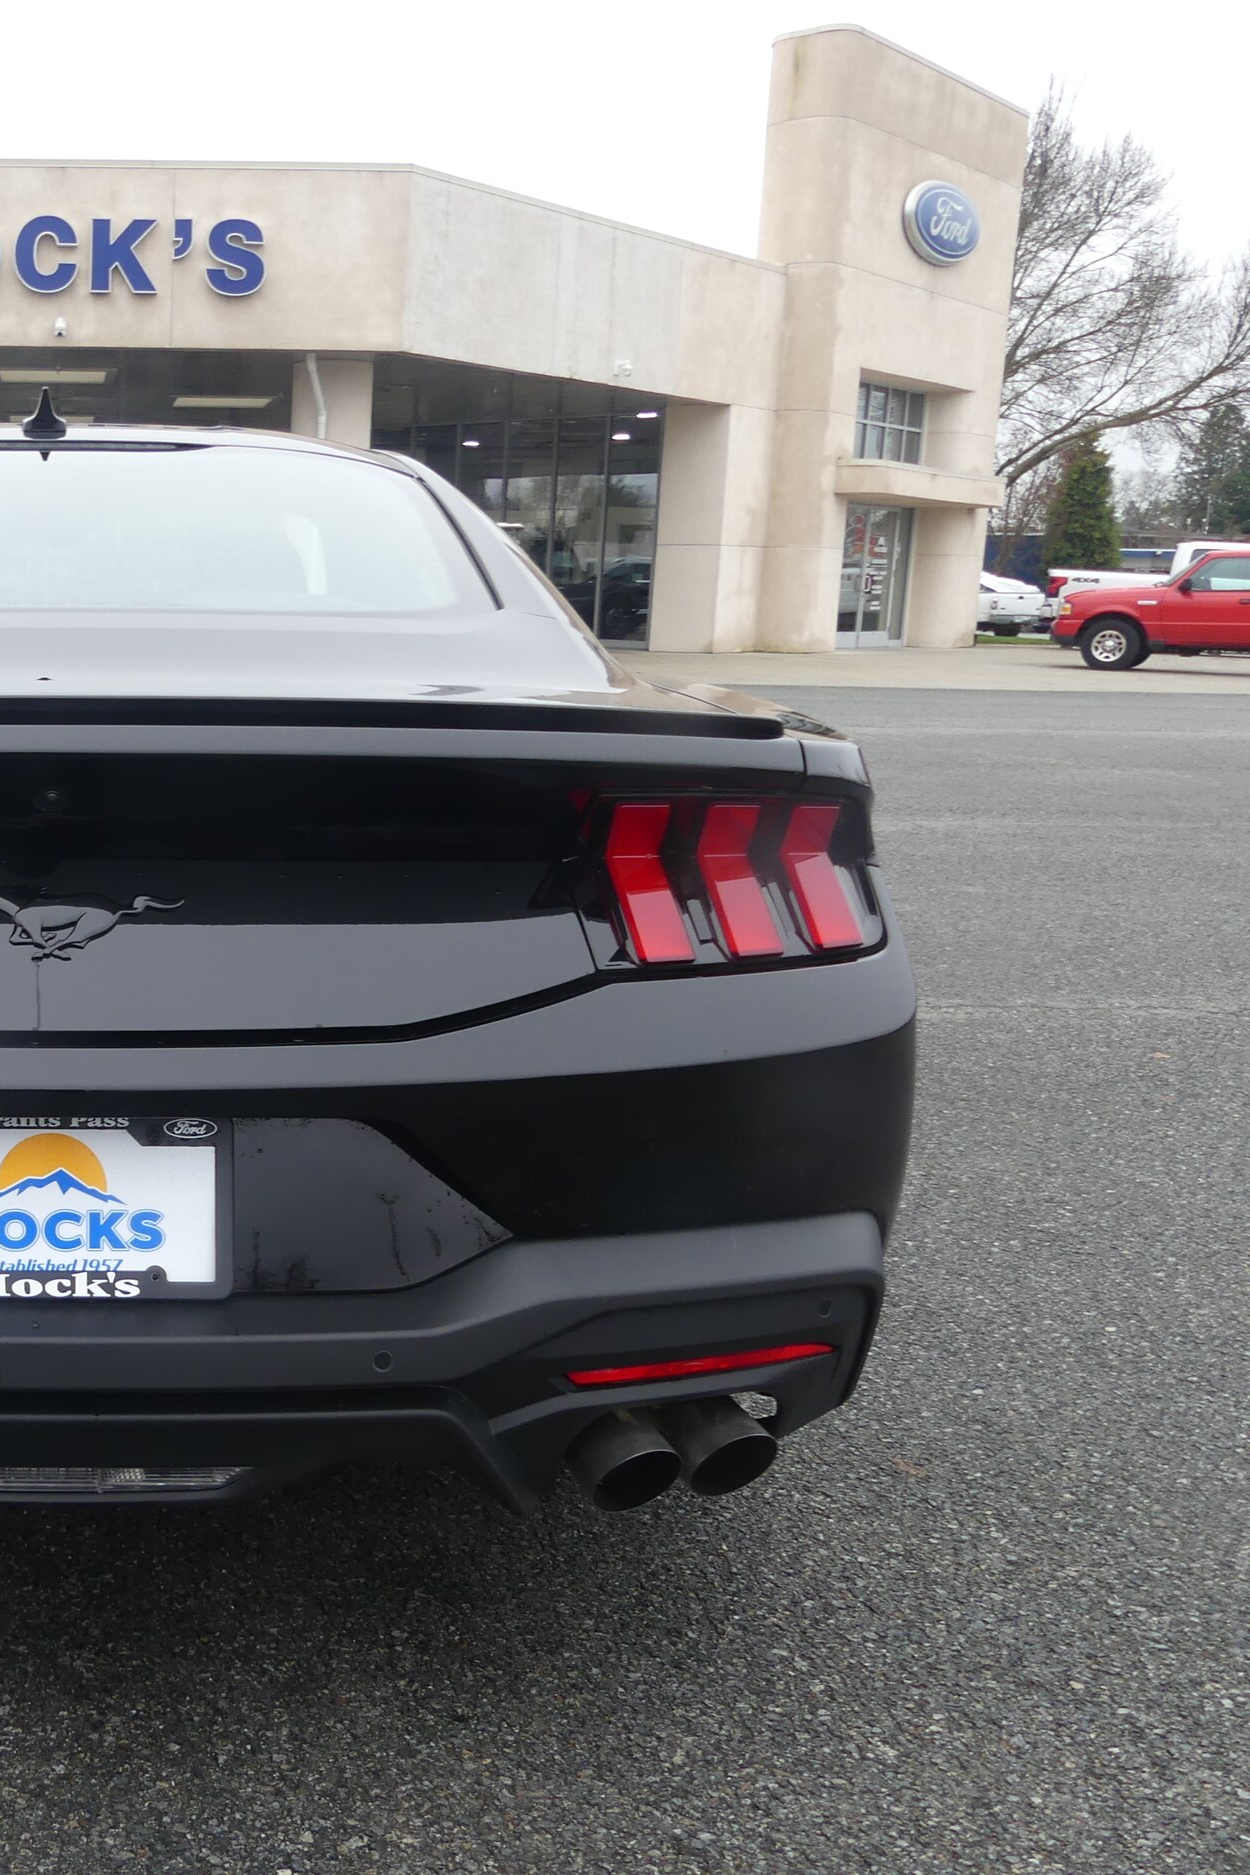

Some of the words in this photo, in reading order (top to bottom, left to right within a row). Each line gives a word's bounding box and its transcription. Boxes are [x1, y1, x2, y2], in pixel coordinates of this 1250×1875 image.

[930, 196, 973, 246] Ford
[69, 1116, 130, 1128] Pass
[173, 1120, 207, 1135] Ford
[82, 1258, 124, 1272] 1957
